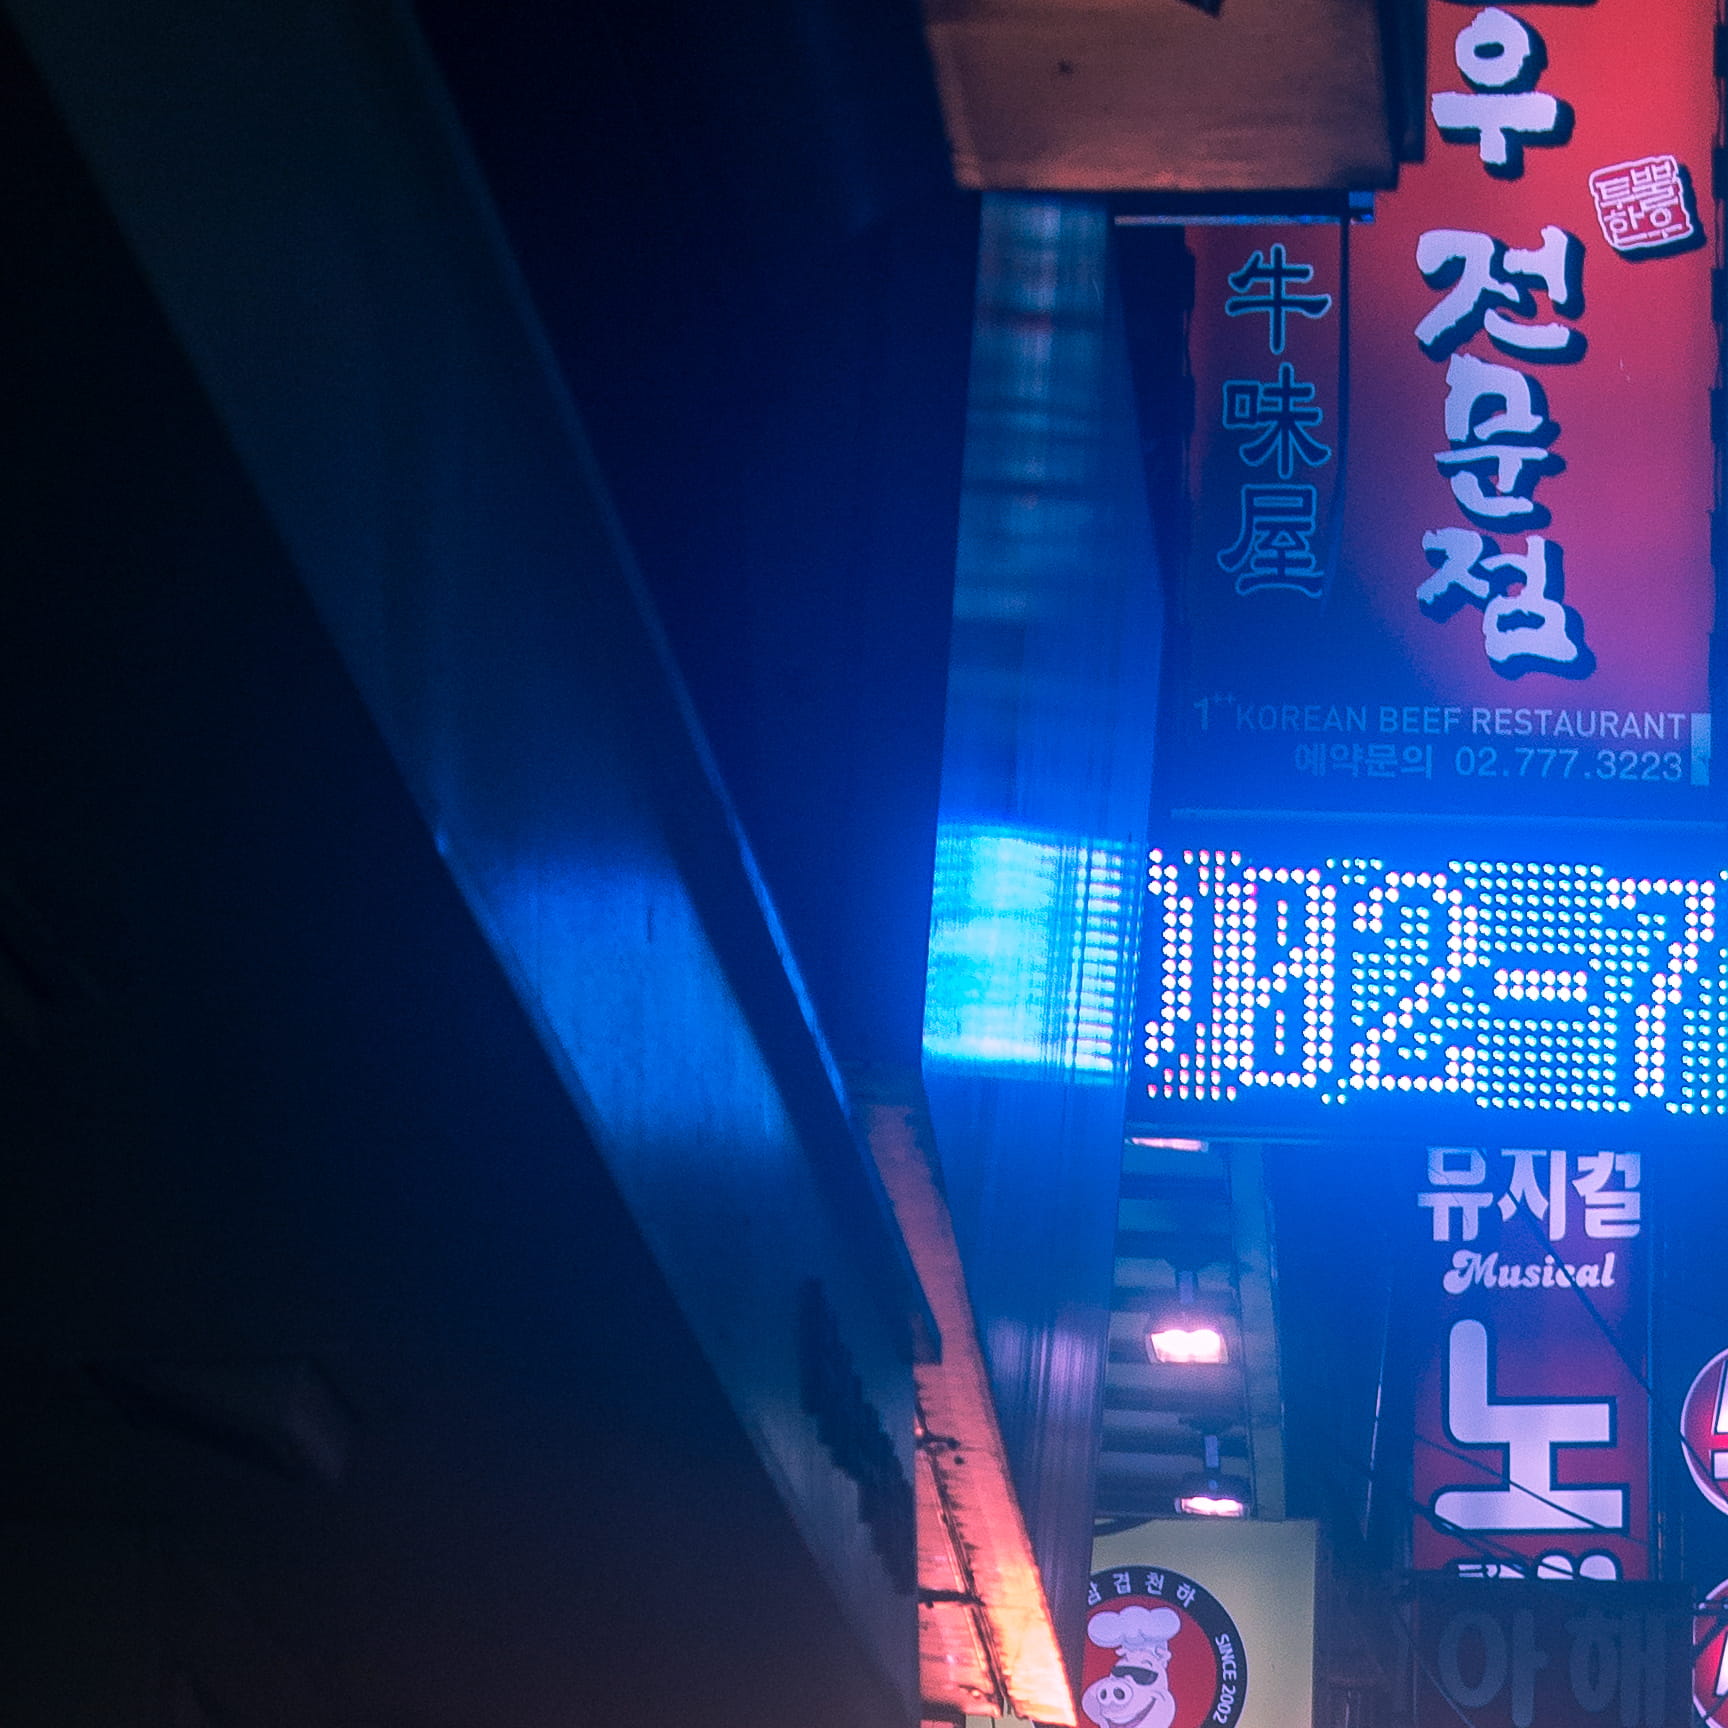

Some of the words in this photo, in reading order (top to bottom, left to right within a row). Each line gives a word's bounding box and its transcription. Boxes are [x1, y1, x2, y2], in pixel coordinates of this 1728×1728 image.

[1432, 6, 1568, 170] 우
[1218, 244, 1332, 598] 牛味屋
[1414, 228, 1582, 668] 전문점
[1236, 704, 1368, 735] KOREAN
[1379, 706, 1462, 735] BEEF
[1471, 708, 1687, 741] RESTAURANT
[1455, 745, 1683, 783] 02.777.3223
[1417, 1146, 1642, 1242] 뮤지컬
[1443, 1250, 1617, 1295] Musical
[1214, 1632, 1238, 1682] SINCE
[1211, 1683, 1237, 1726] 2002
